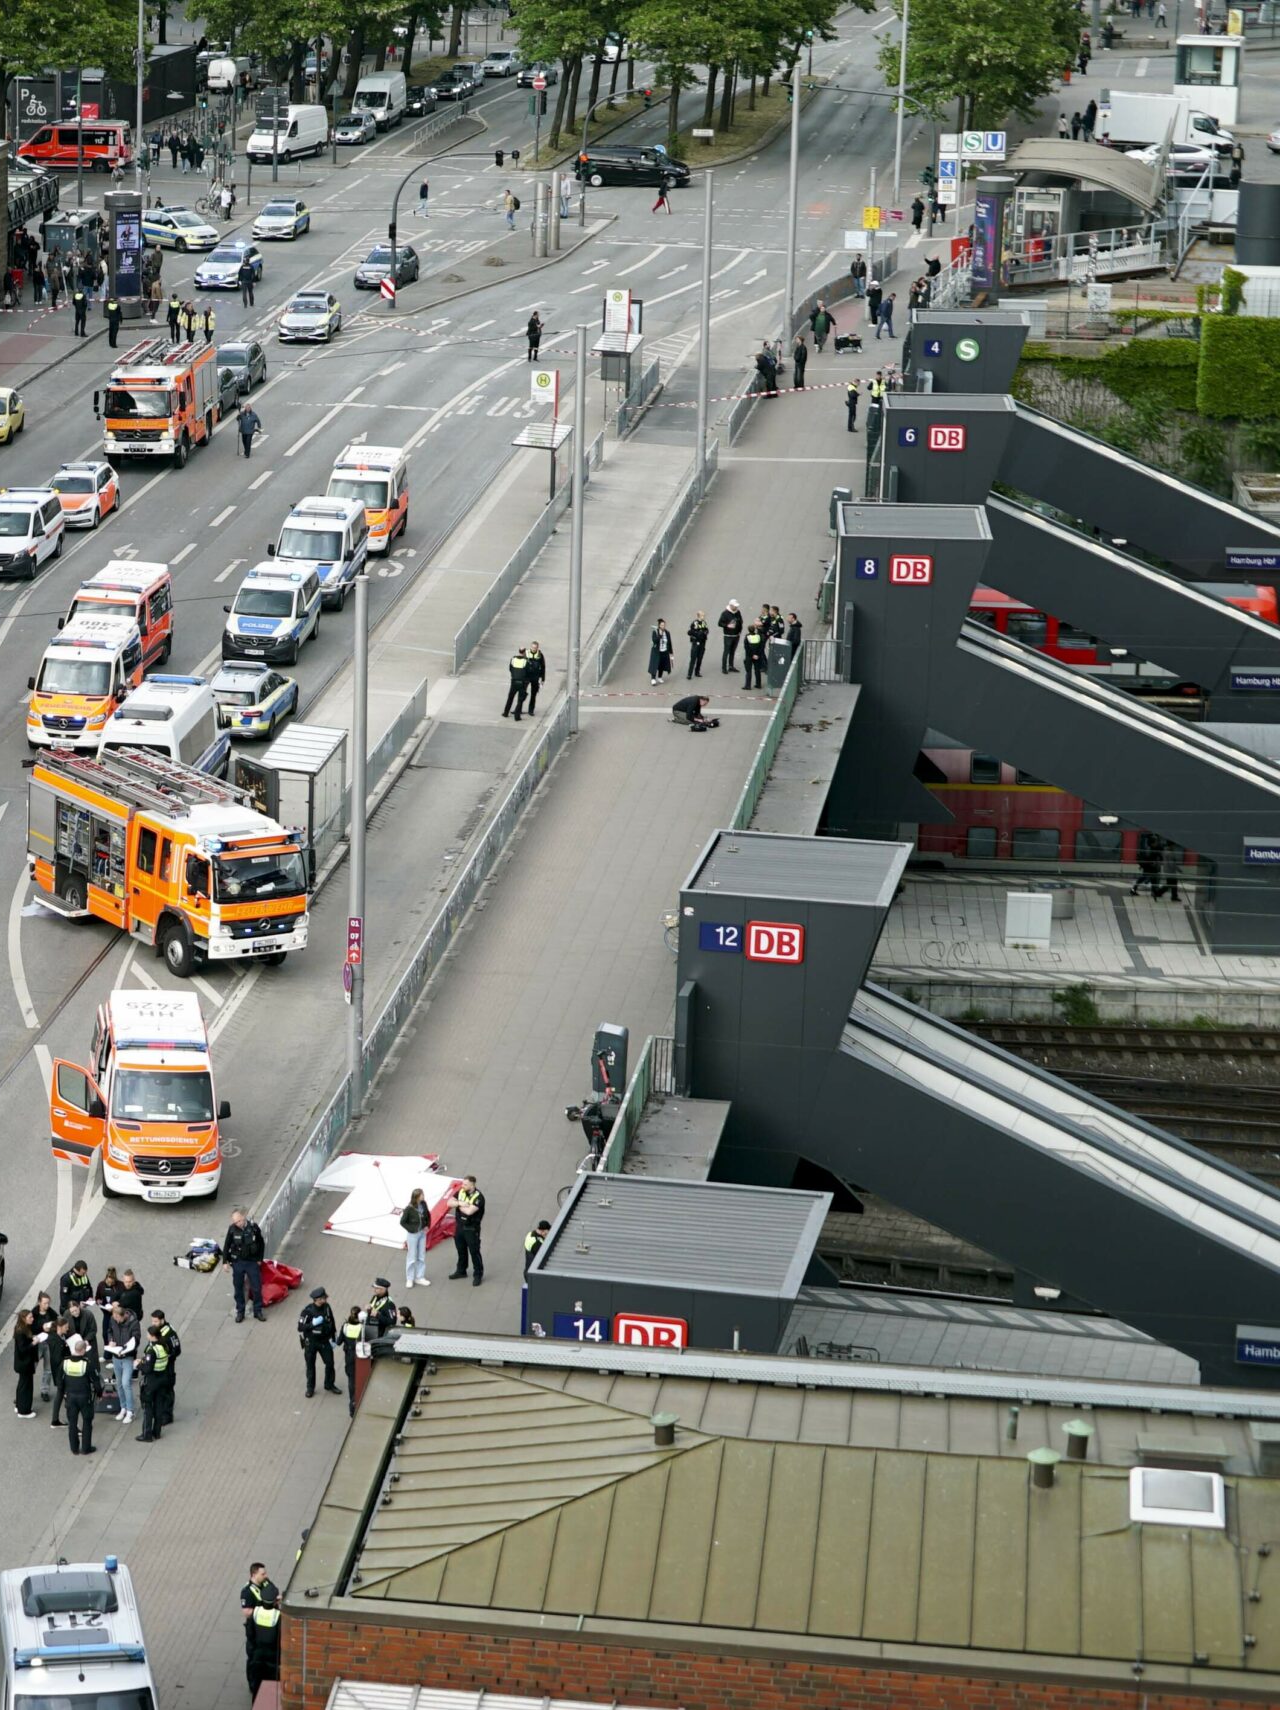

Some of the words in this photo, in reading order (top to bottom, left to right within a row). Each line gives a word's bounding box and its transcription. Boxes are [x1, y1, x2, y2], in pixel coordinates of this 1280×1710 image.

[21, 88, 30, 101] P
[987, 134, 1002, 150] U
[931, 341, 940, 354] 4
[905, 428, 915, 442] 6
[933, 430, 960, 446] DB
[1230, 556, 1262, 566] Hamburg
[864, 559, 875, 574] 8
[896, 560, 927, 580] DB
[1235, 675, 1270, 687] Hamburg
[715, 926, 738, 946] 12
[753, 929, 796, 956] DB
[126, 1002, 184, 1010] 2425
[129, 1136, 199, 1144] RETTUNGSDIENST
[573, 1319, 603, 1342] 14
[623, 1323, 677, 1347] DB
[47, 1613, 102, 1630] 211
